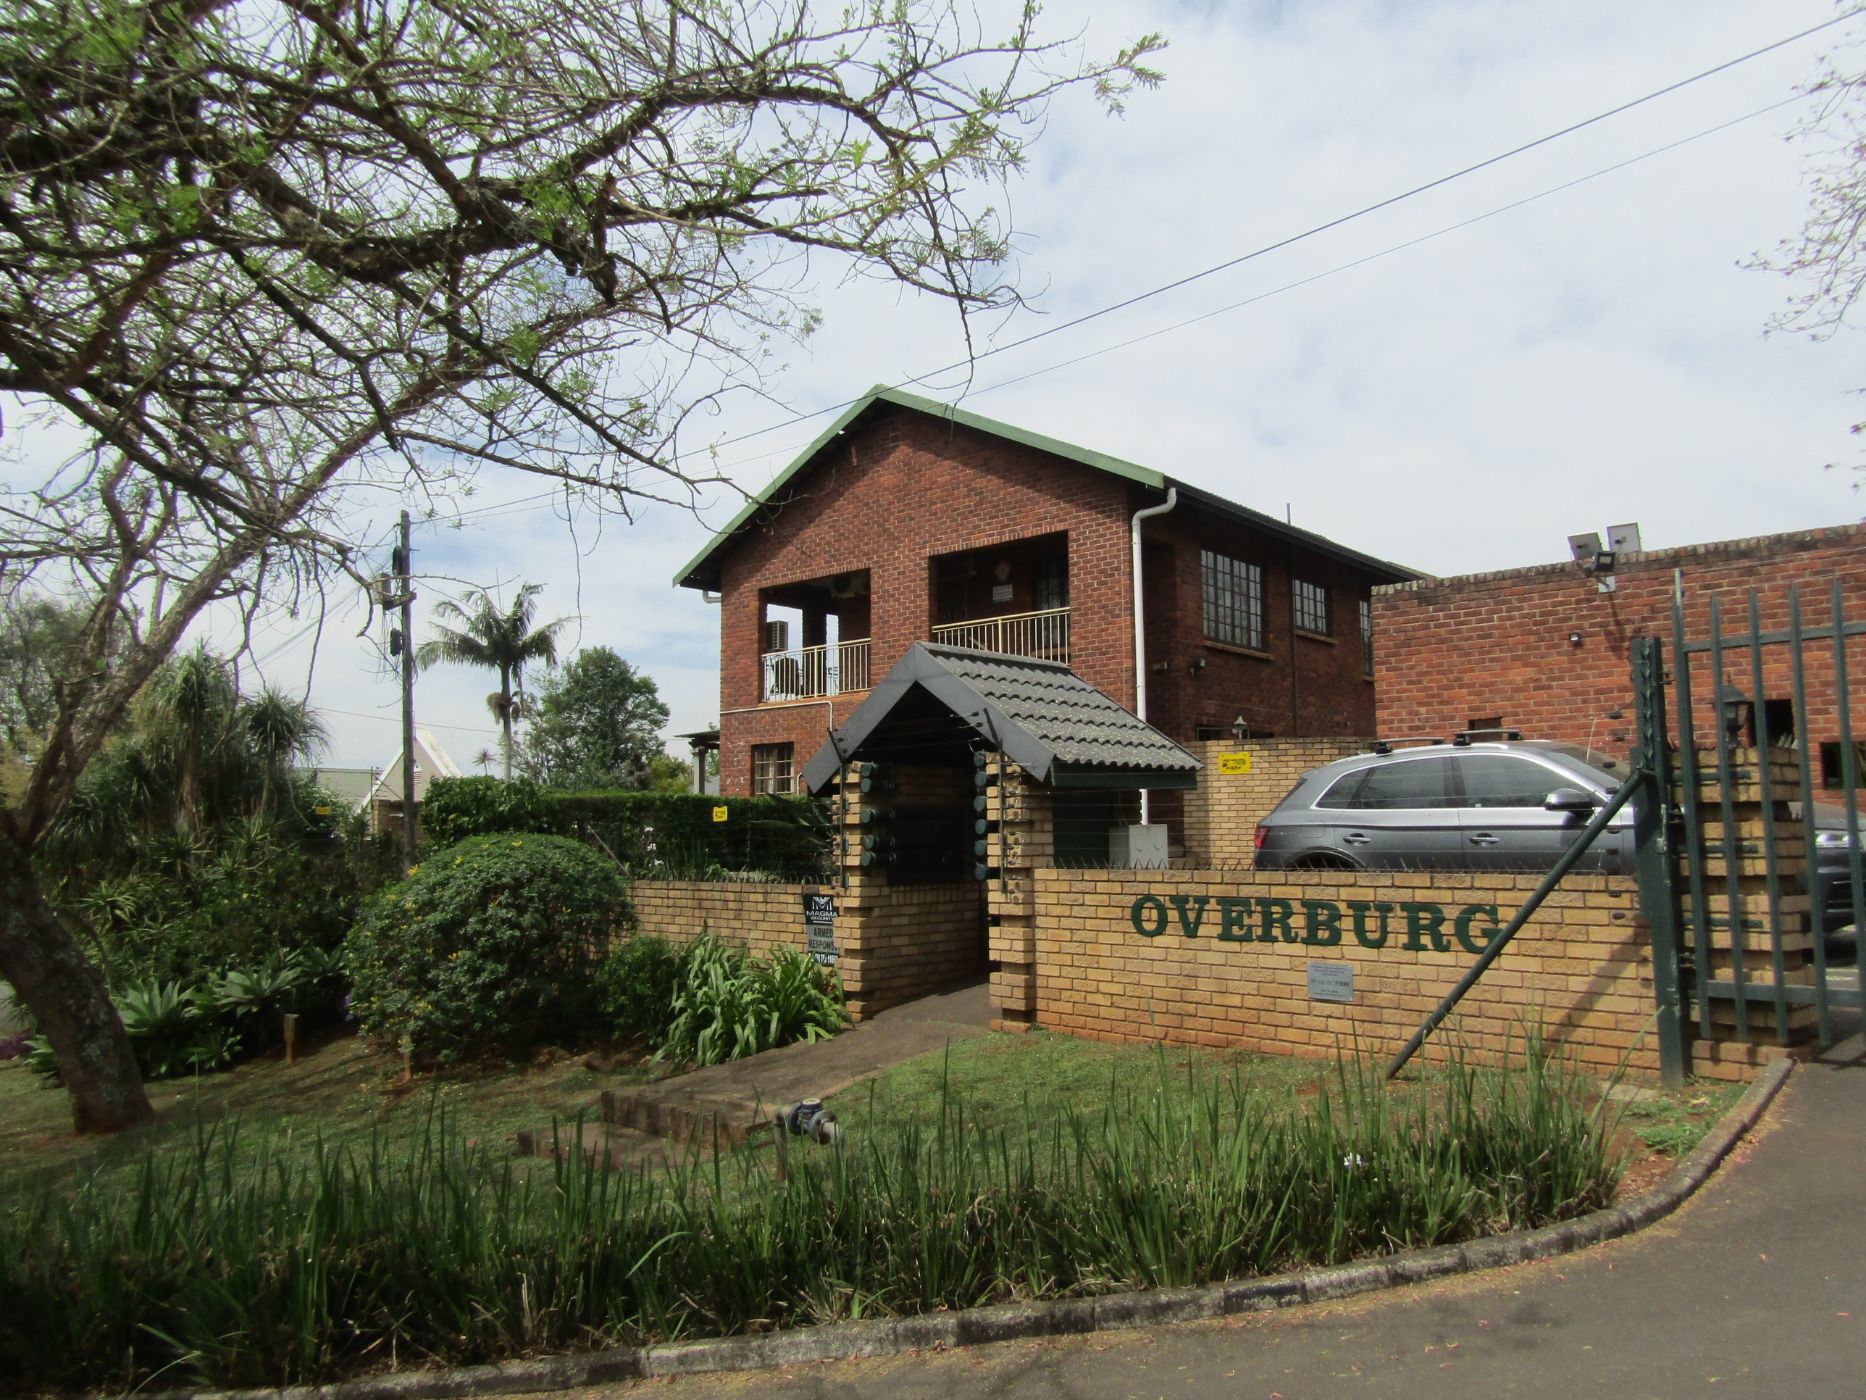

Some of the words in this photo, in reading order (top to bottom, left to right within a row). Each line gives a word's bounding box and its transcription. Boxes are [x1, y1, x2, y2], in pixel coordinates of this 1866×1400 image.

[1130, 894, 1504, 956] OVERBURG
[814, 927, 834, 938] ARMED
[808, 939, 837, 951] RESPONS
